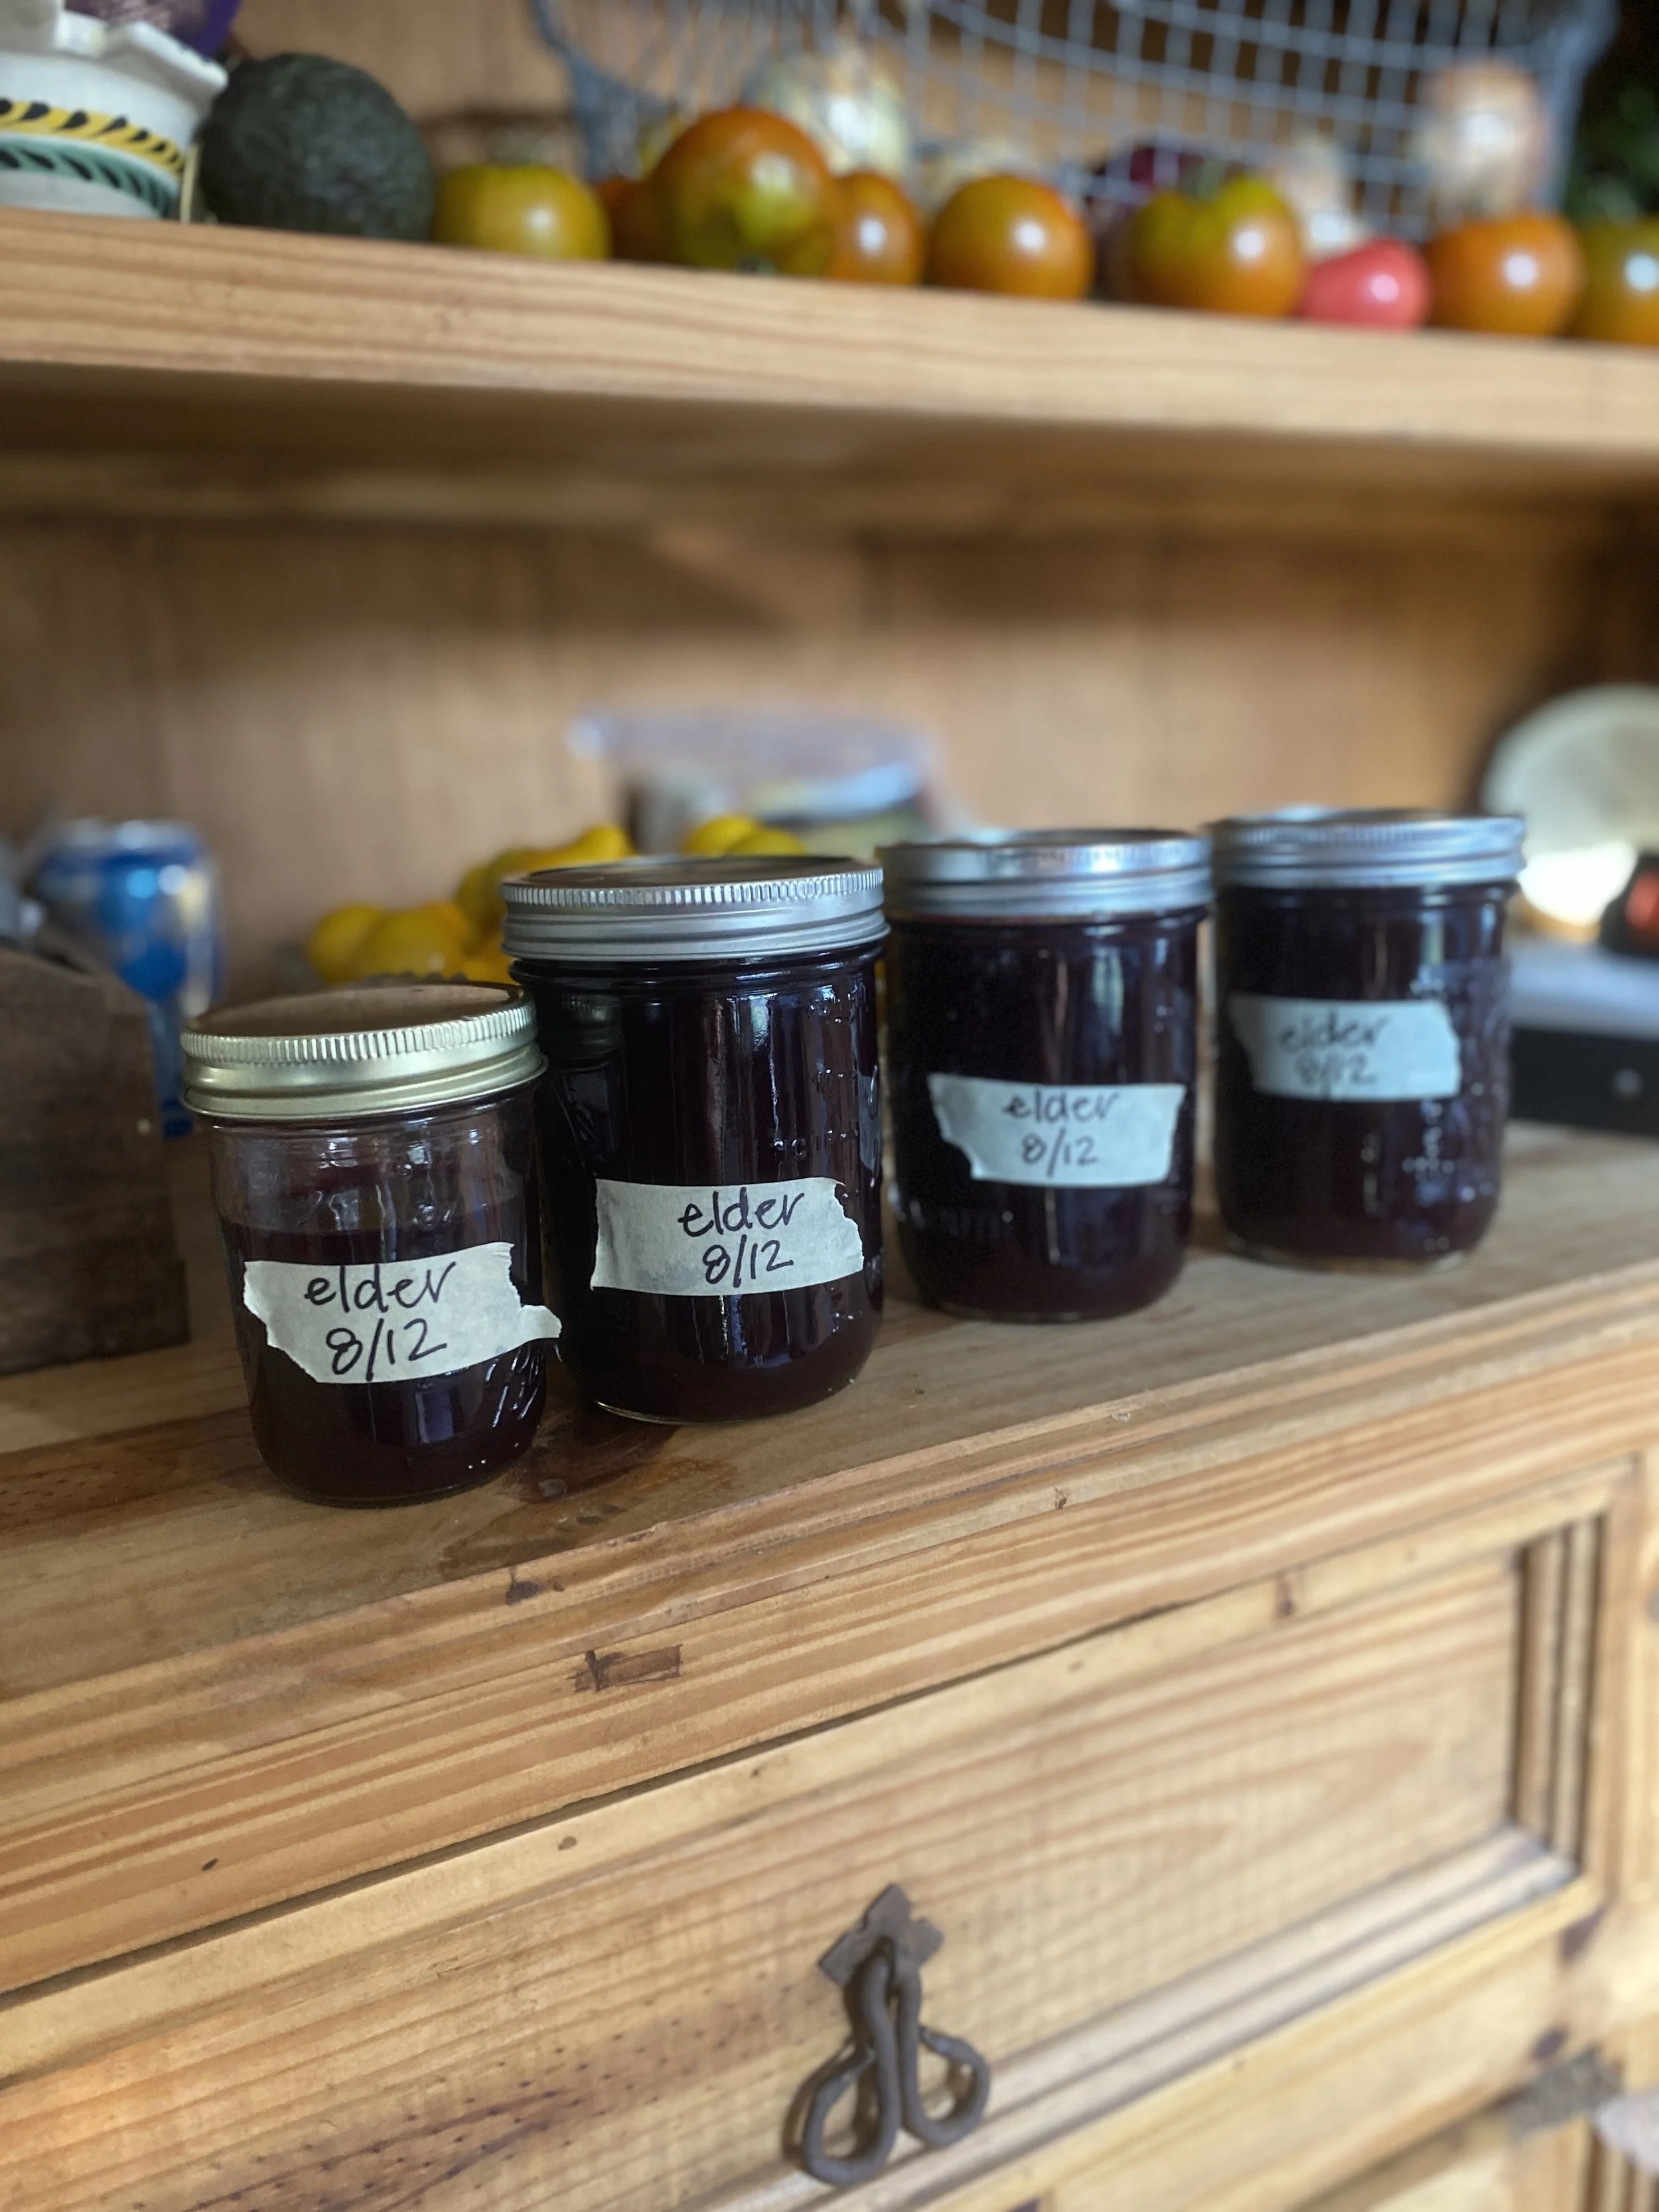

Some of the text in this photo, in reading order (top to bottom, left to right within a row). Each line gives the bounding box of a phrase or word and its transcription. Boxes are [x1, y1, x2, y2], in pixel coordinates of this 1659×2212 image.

[1278, 1010, 1391, 1054] elder
[1001, 1088, 1121, 1123] elder
[1021, 1126, 1099, 1178] 8/12
[678, 1187, 805, 1237] elder
[702, 1234, 794, 1288] 8/12
[305, 1262, 457, 1313] elder
[326, 1318, 447, 1381] 8/12
